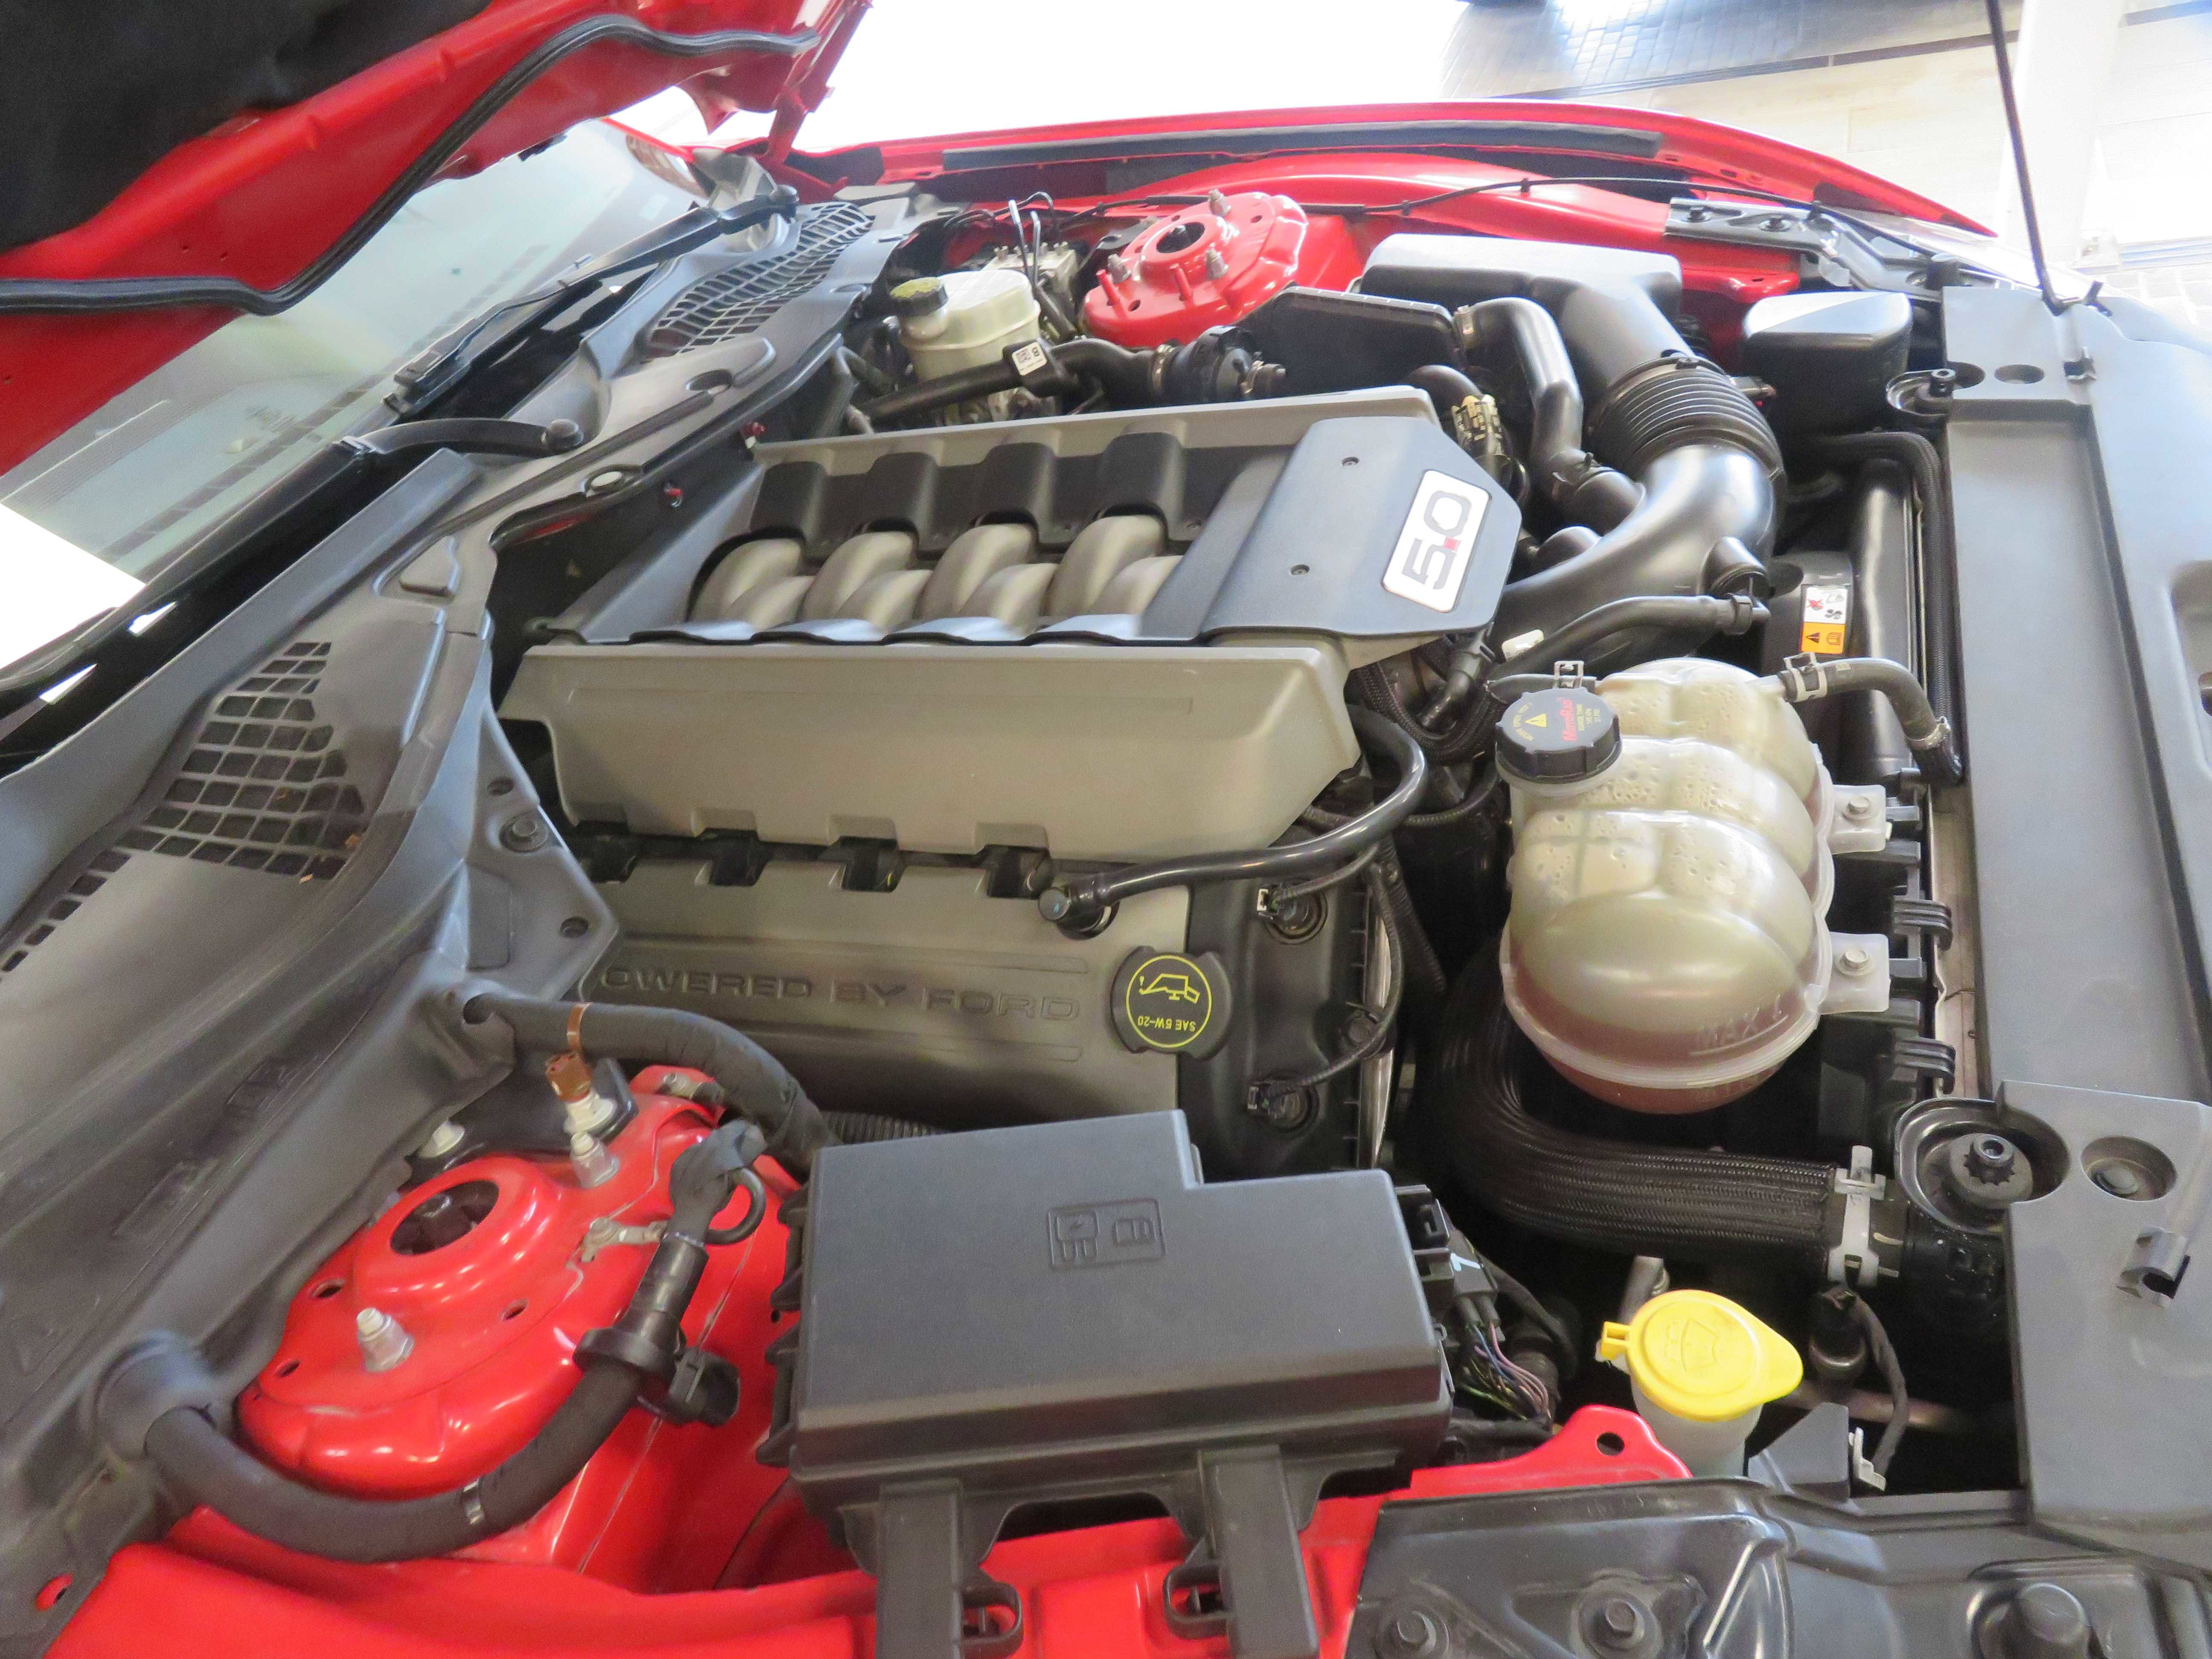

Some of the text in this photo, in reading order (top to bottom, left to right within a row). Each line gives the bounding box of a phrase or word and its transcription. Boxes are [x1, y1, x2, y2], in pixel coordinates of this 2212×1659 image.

[1401, 490, 1473, 590] 5.0
[1513, 714, 1522, 727] OPEN
[600, 968, 1080, 1021] OWERED BY FORD
[1137, 1016, 1196, 1032] SAE 5W-20
